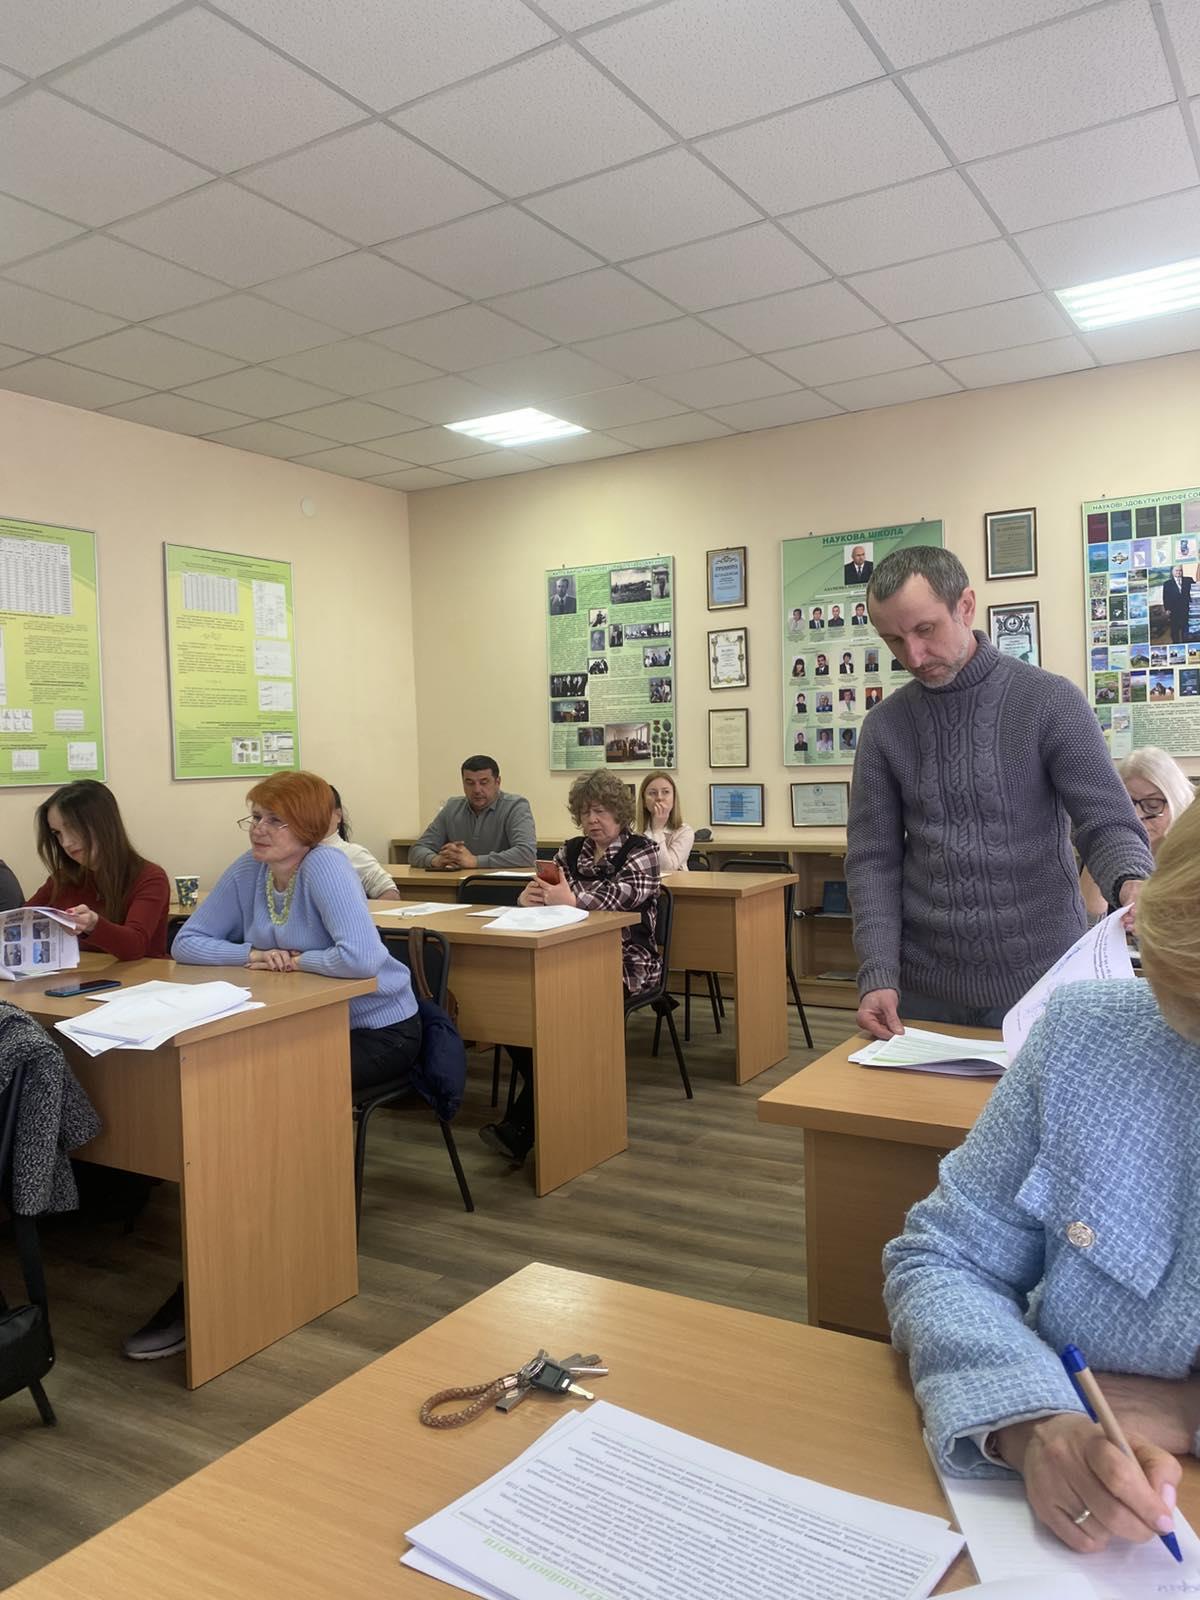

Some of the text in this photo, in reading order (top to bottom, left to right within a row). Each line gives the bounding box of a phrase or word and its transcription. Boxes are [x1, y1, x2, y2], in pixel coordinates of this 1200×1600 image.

[1125, 497, 1161, 507] ЗДОБУТКИ
[822, 528, 904, 544] НАУКОВА ШКОЛА
